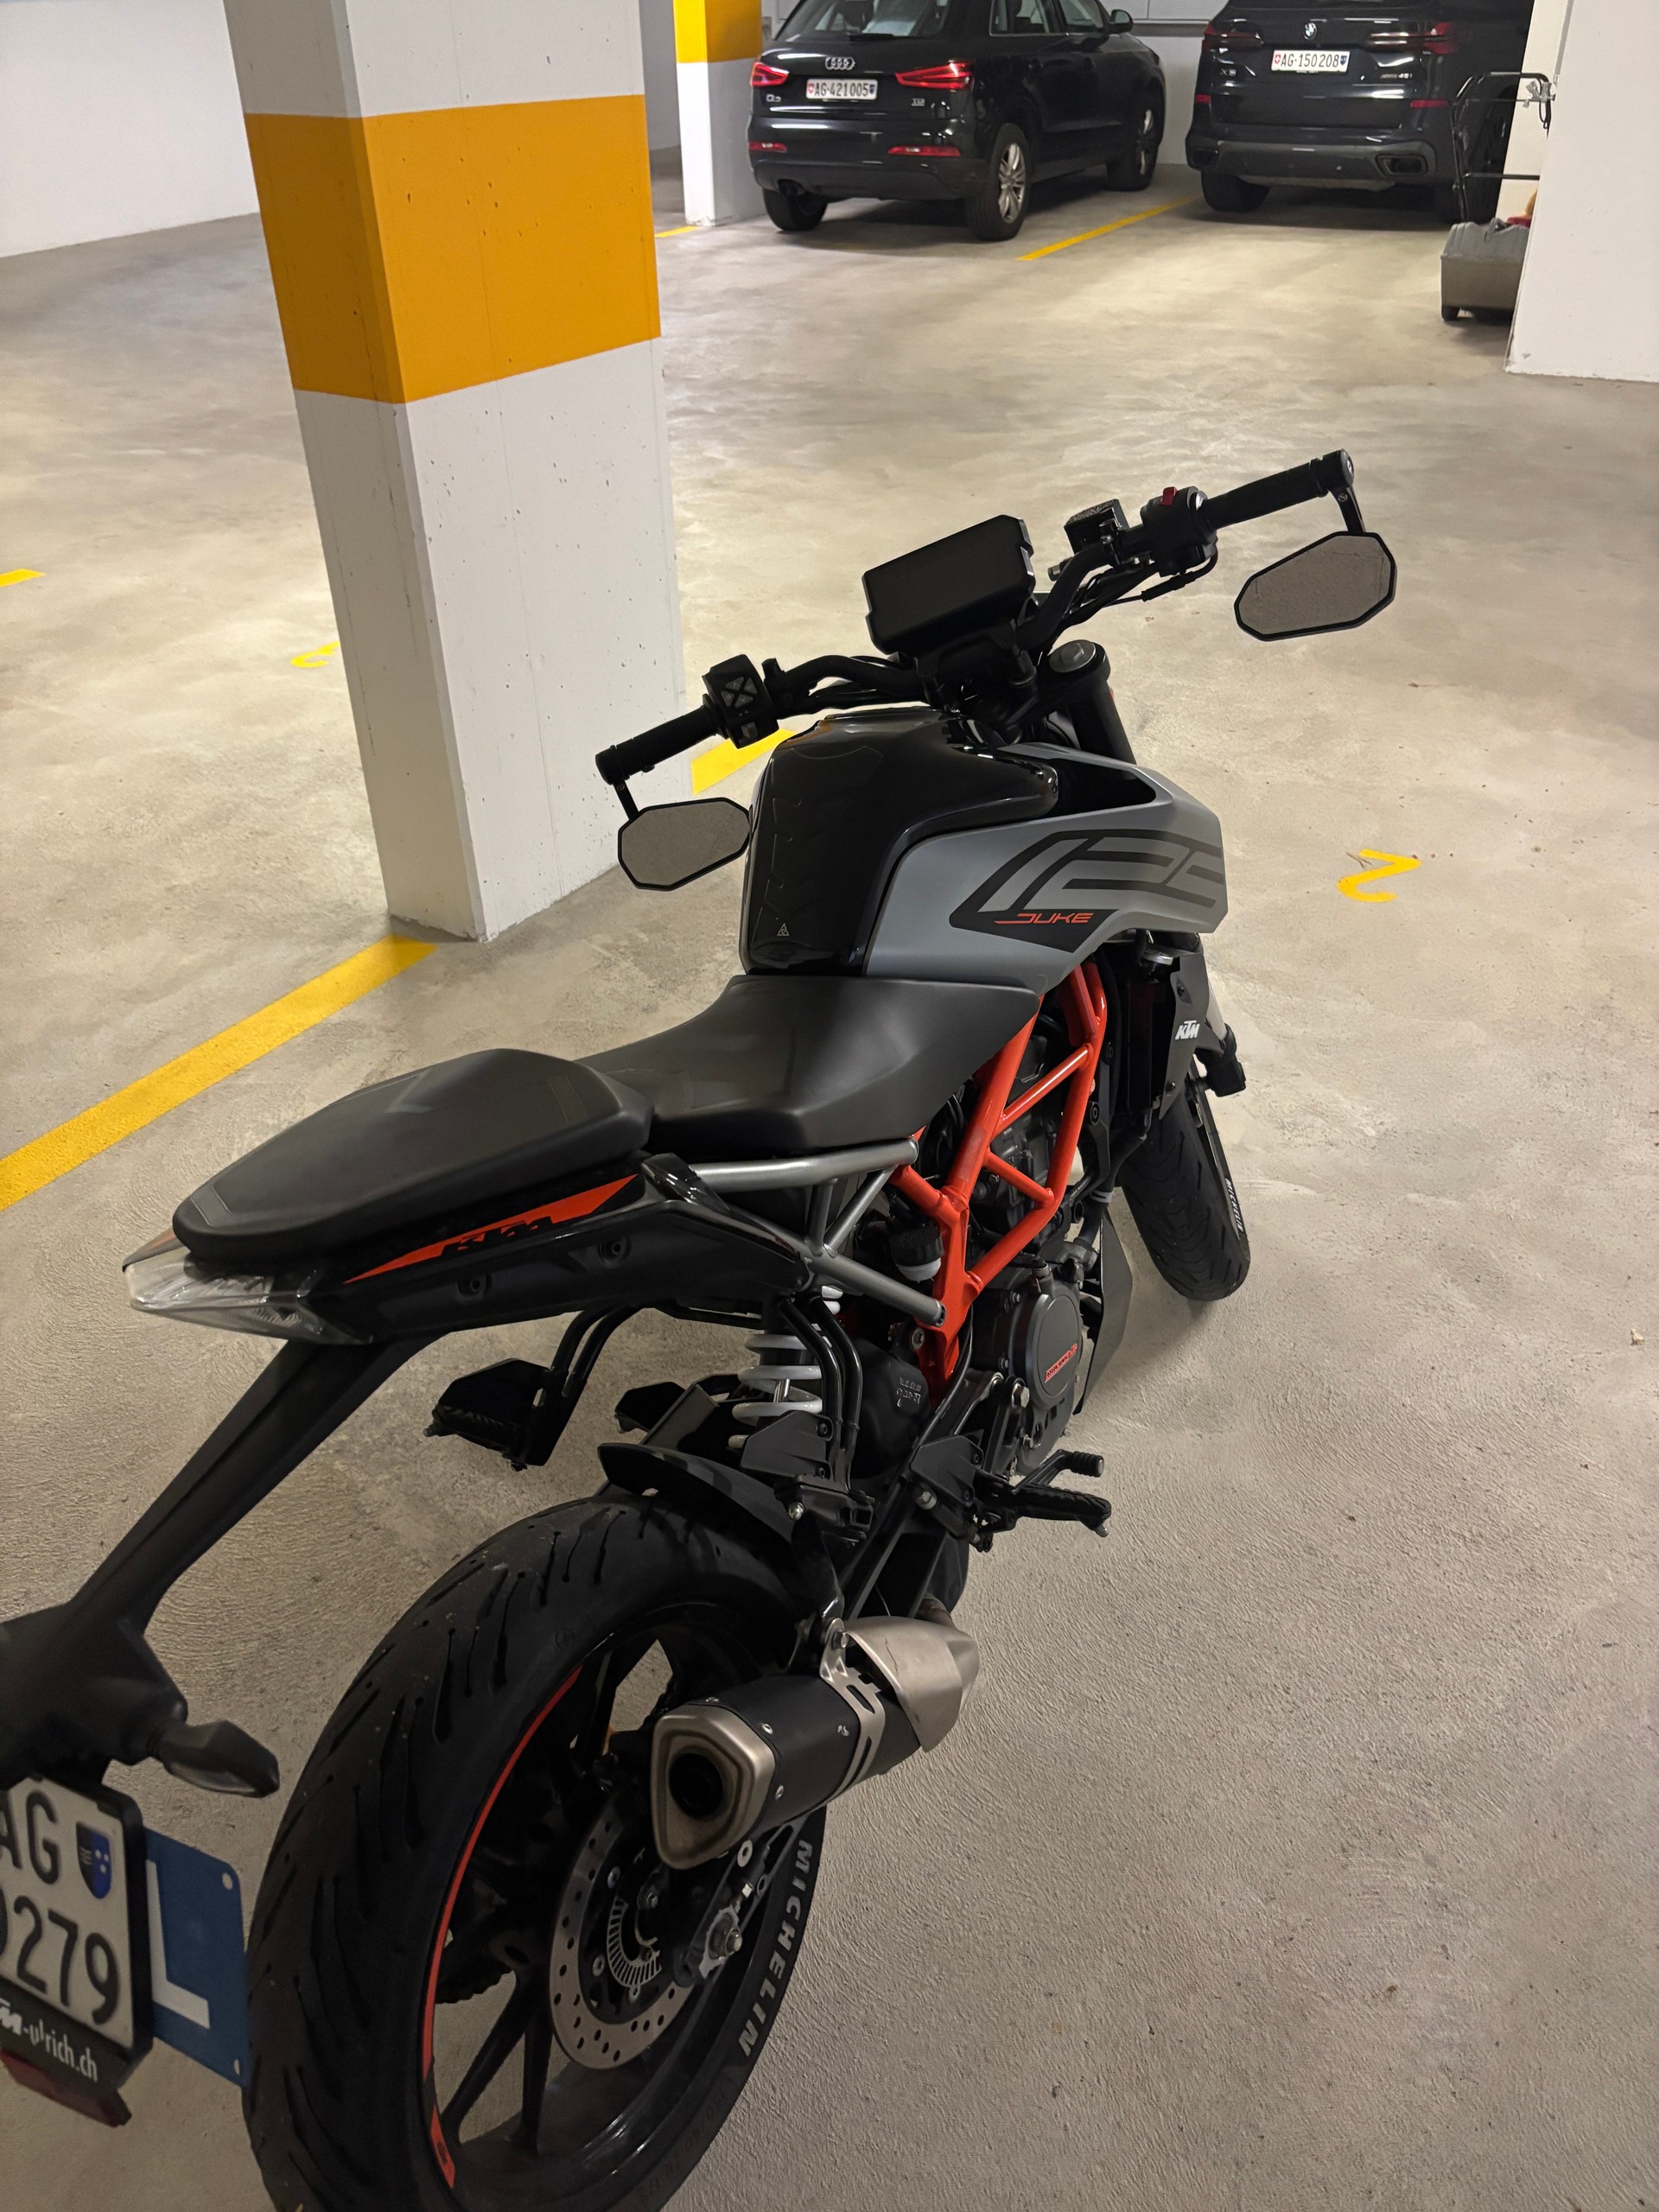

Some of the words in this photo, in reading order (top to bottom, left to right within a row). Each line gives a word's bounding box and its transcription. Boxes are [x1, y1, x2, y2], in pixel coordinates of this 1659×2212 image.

[994, 912, 1094, 925] DUKE
[1175, 1020, 1200, 1039] KTM
[1224, 1178, 1244, 1232] MICHELIN
[0, 1885, 119, 2025] 279
[146, 1859, 210, 2030] L
[739, 1840, 813, 2056] MICHELIN
